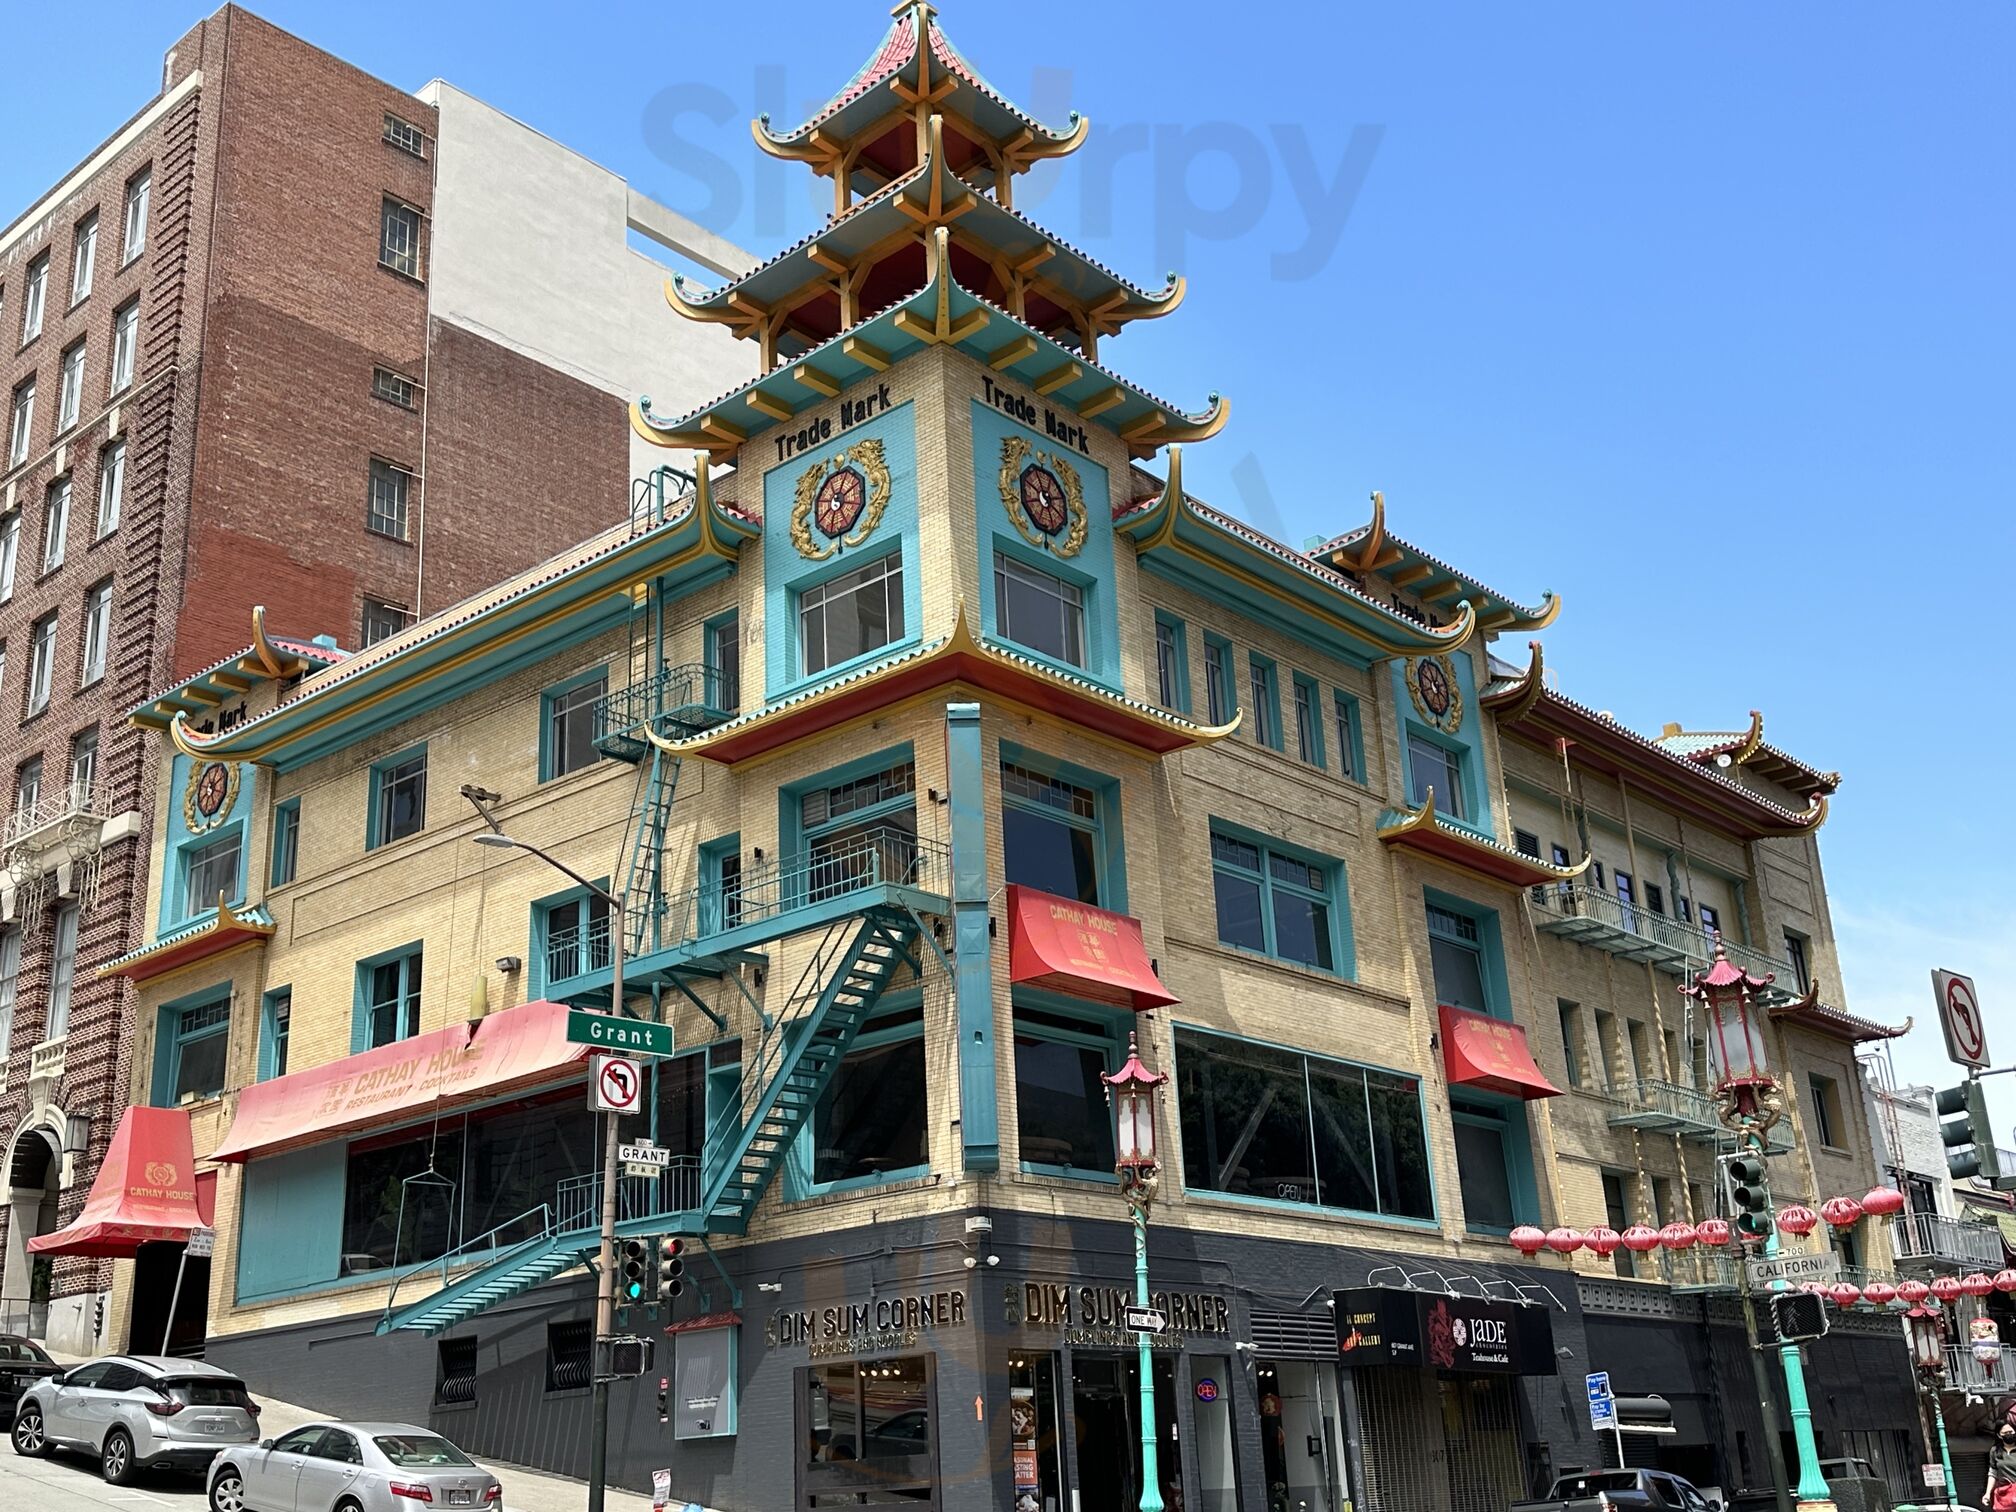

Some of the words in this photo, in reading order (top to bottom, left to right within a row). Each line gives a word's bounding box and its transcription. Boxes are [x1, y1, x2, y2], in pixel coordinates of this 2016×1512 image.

[775, 417, 831, 462] Trade
[840, 383, 892, 430] Mark
[982, 375, 1036, 425] Trade
[1045, 409, 1090, 454] Mark
[1049, 905, 1085, 926] CATHAY
[1087, 913, 1119, 936] HOUSE
[590, 1021, 653, 1046] Grant
[354, 1056, 423, 1095] CATHAY
[344, 1084, 414, 1112] RESTAURANT
[419, 1067, 478, 1091] COCKTAILS
[622, 1147, 666, 1163] GRANT
[130, 1186, 163, 1199] CATHAY
[165, 1189, 195, 1201] HOUSE
[1277, 1183, 1302, 1200] OPEN
[1786, 1246, 1803, 1256] 700
[1756, 1257, 1831, 1278] CALIFORNIA
[779, 1310, 818, 1346] DIM
[822, 1302, 871, 1339] SUM
[876, 1289, 967, 1332] CORNER
[1024, 1282, 1073, 1326] DIM
[1078, 1286, 1133, 1328] SUM
[1149, 1291, 1230, 1334] ORNER
[1131, 1314, 1145, 1325] ONE
[808, 1339, 856, 1358] DUMPLINGS
[857, 1336, 876, 1350] AND
[877, 1332, 917, 1349] NOODLES
[1064, 1328, 1121, 1347] DUMPLINGS
[1150, 1333, 1185, 1349] OODLES
[1197, 1383, 1217, 1397] OPEN
